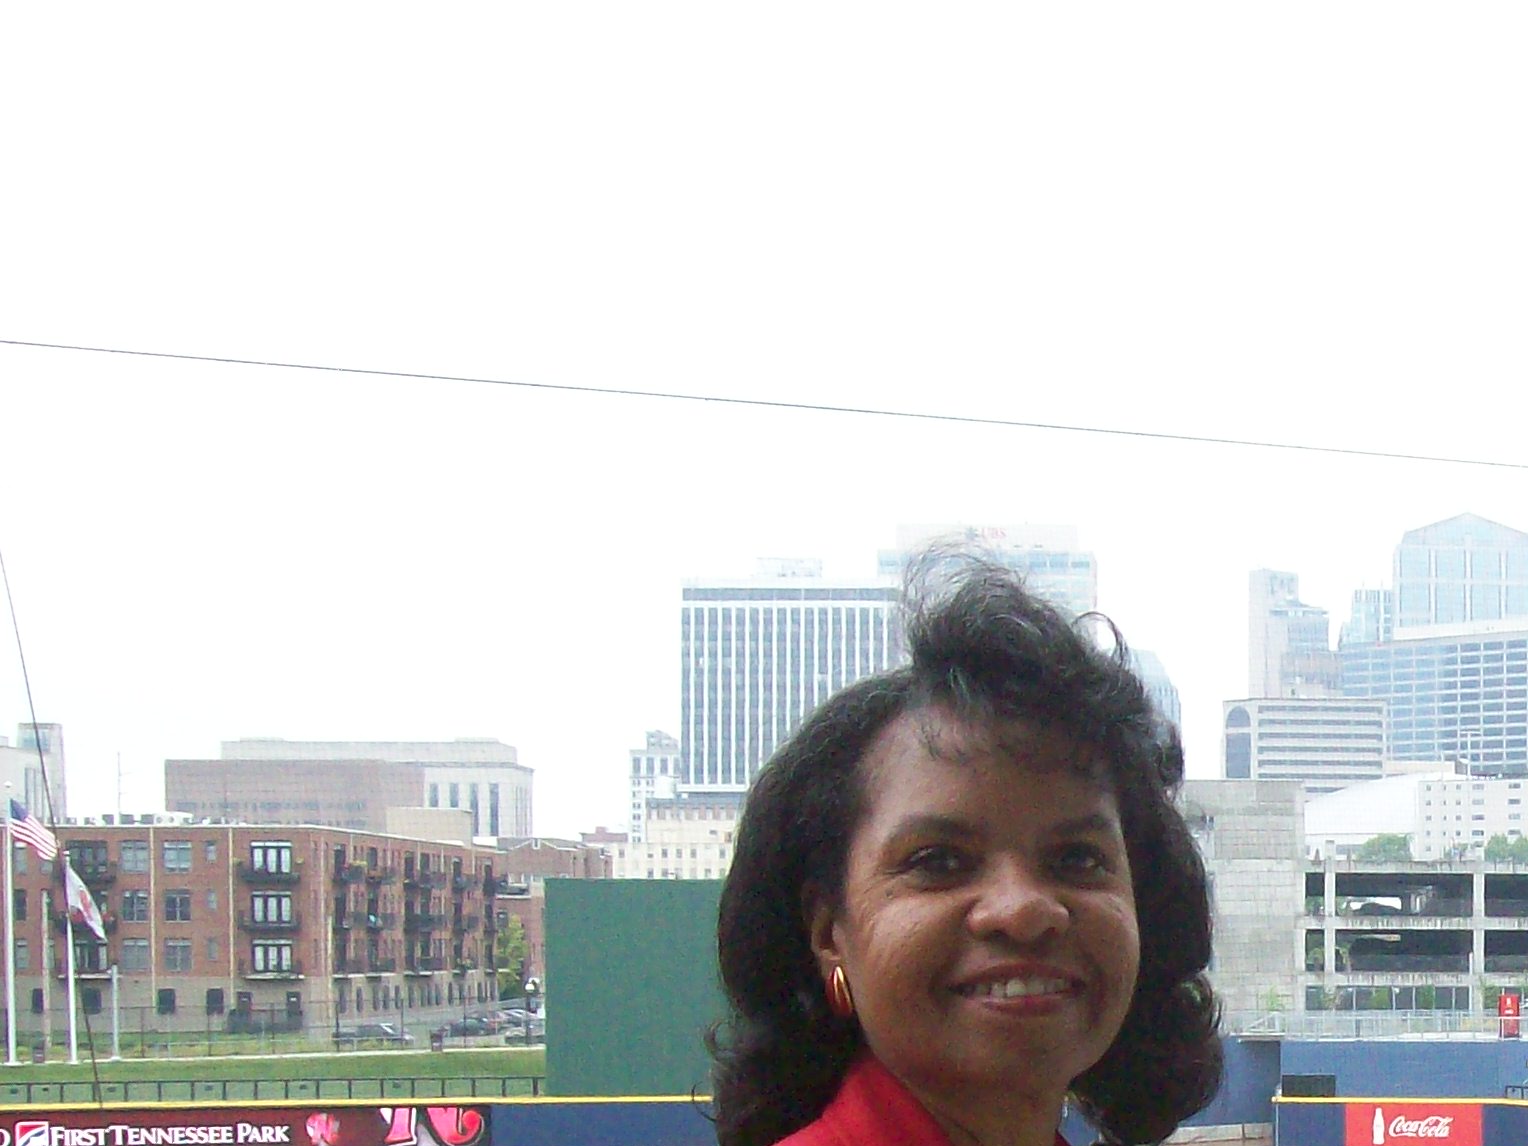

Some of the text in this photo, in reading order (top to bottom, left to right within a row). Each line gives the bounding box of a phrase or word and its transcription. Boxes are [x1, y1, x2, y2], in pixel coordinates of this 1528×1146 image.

[50, 1122, 290, 1146] FIRST TENNESSEE PARK
